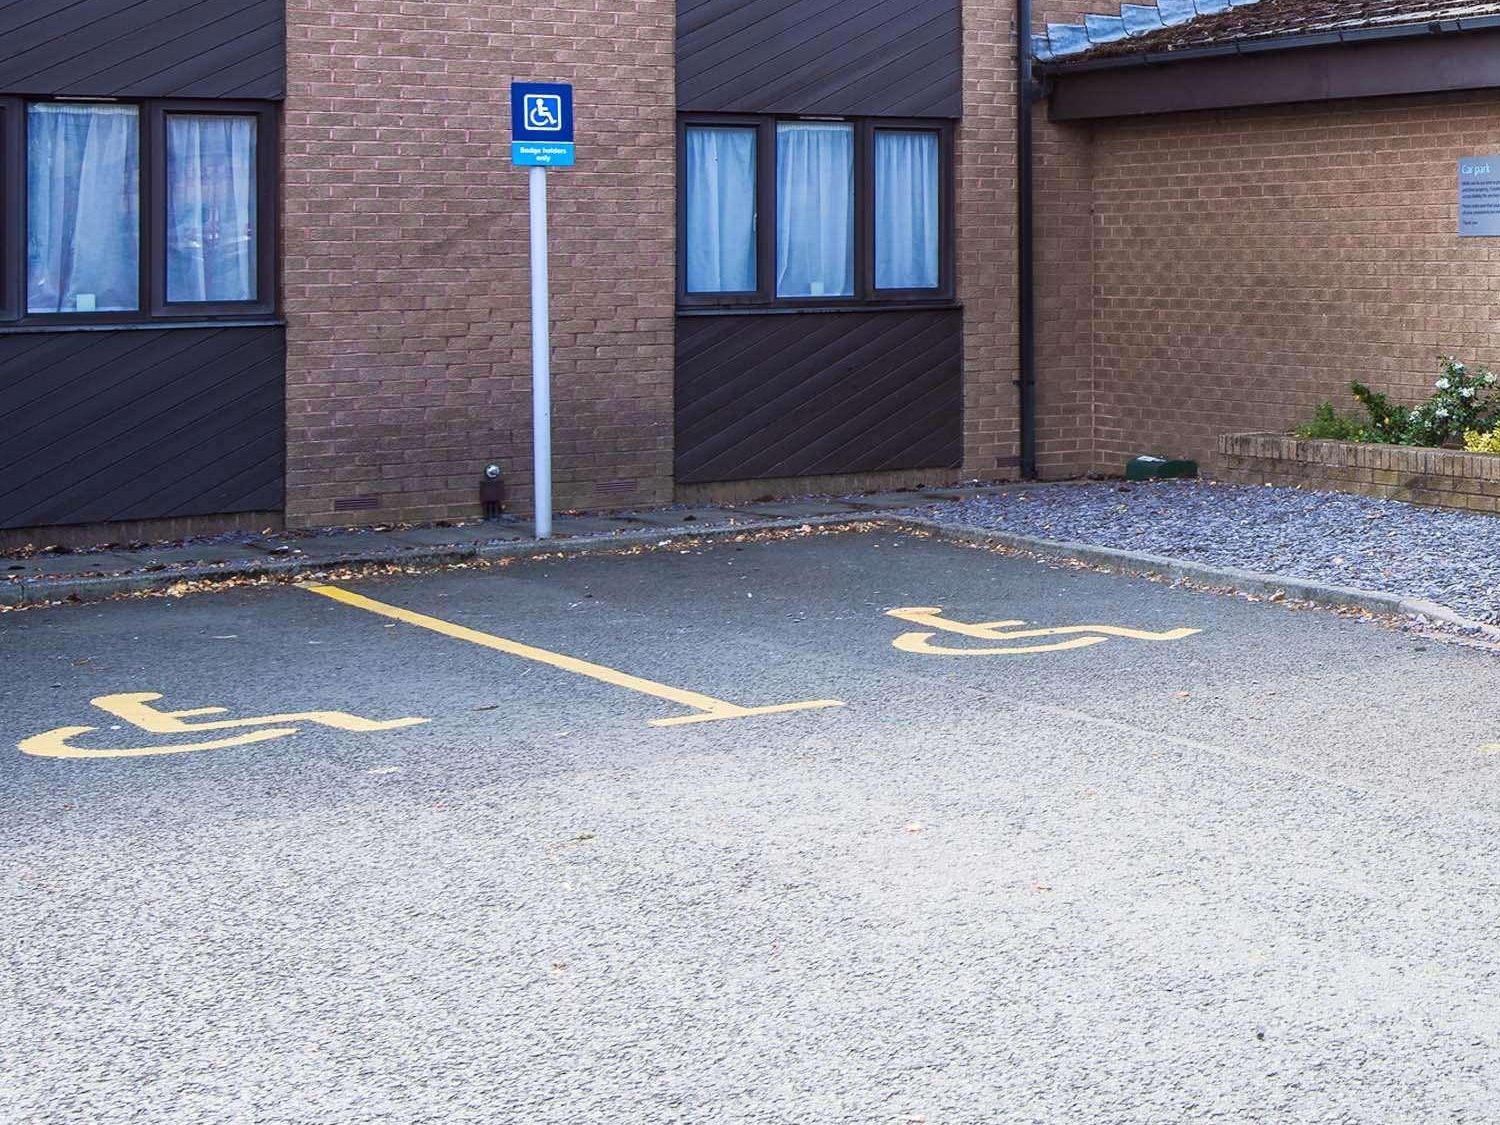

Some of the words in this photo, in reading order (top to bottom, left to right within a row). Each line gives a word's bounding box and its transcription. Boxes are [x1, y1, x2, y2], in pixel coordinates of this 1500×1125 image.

[520, 147, 541, 155] Badge
[1461, 164, 1474, 174] Car
[1474, 162, 1491, 177] park
